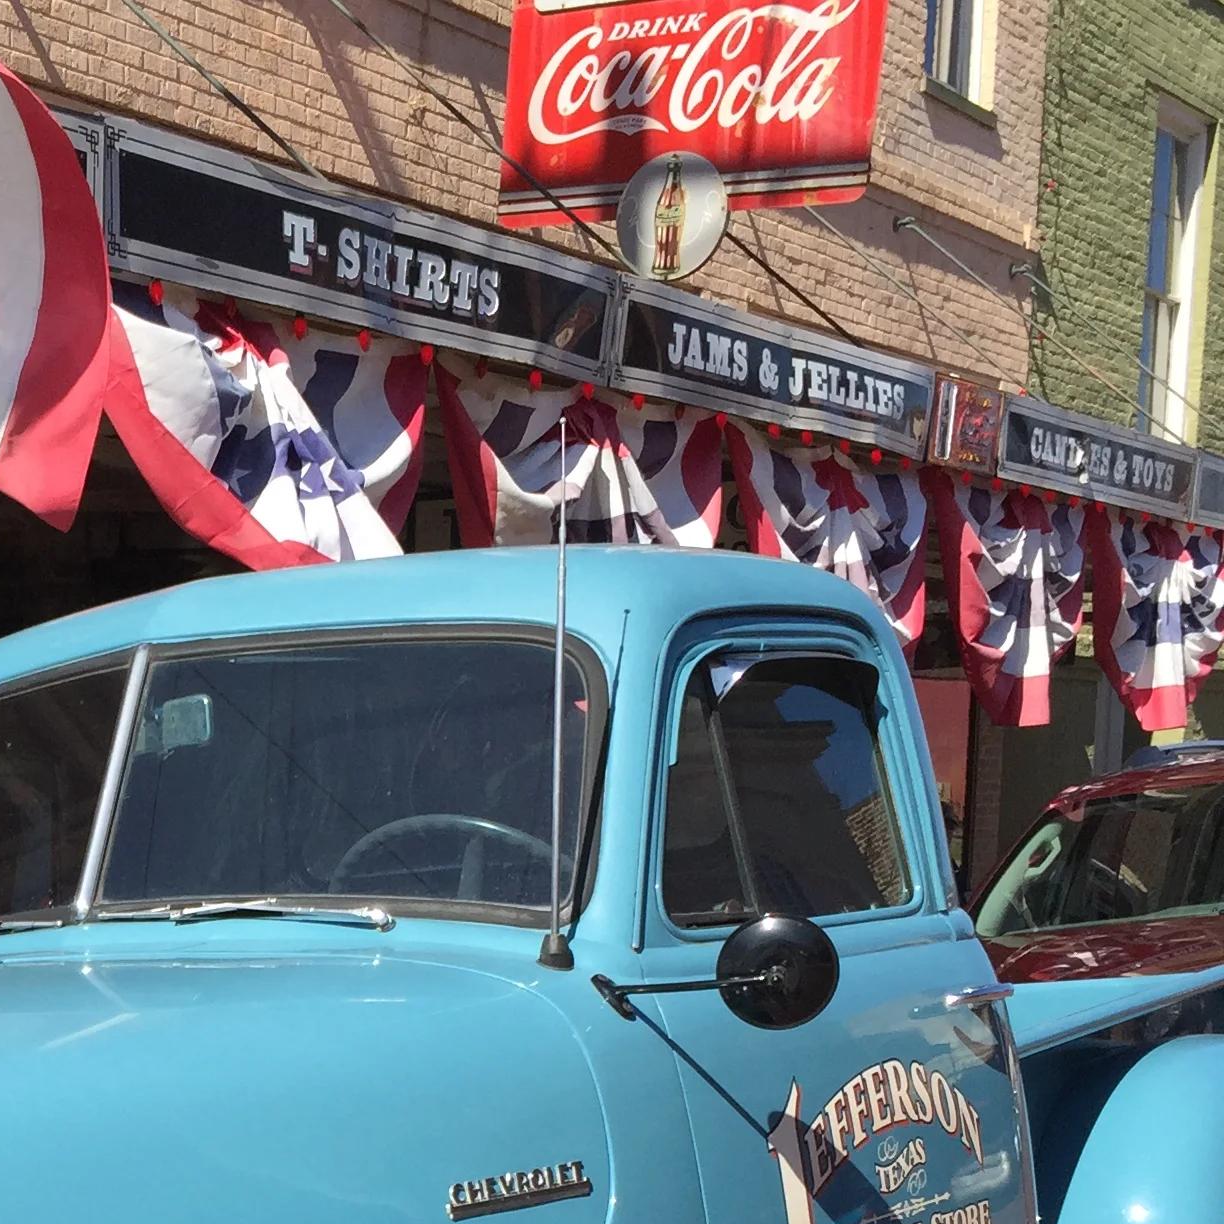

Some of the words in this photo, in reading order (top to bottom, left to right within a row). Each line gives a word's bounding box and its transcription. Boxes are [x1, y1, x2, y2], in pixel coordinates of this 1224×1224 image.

[607, 12, 709, 42] DRINK
[528, 0, 860, 145] Coca-Cola
[668, 322, 749, 382] JAMS
[759, 348, 780, 391] &
[789, 357, 905, 421] JELLIES
[1030, 427, 1112, 477] CANDES
[1114, 450, 1127, 485] &
[1132, 455, 1175, 492] TOYS
[449, 1161, 585, 1206] CHEVROLET
[875, 1137, 927, 1194] TEXAS
